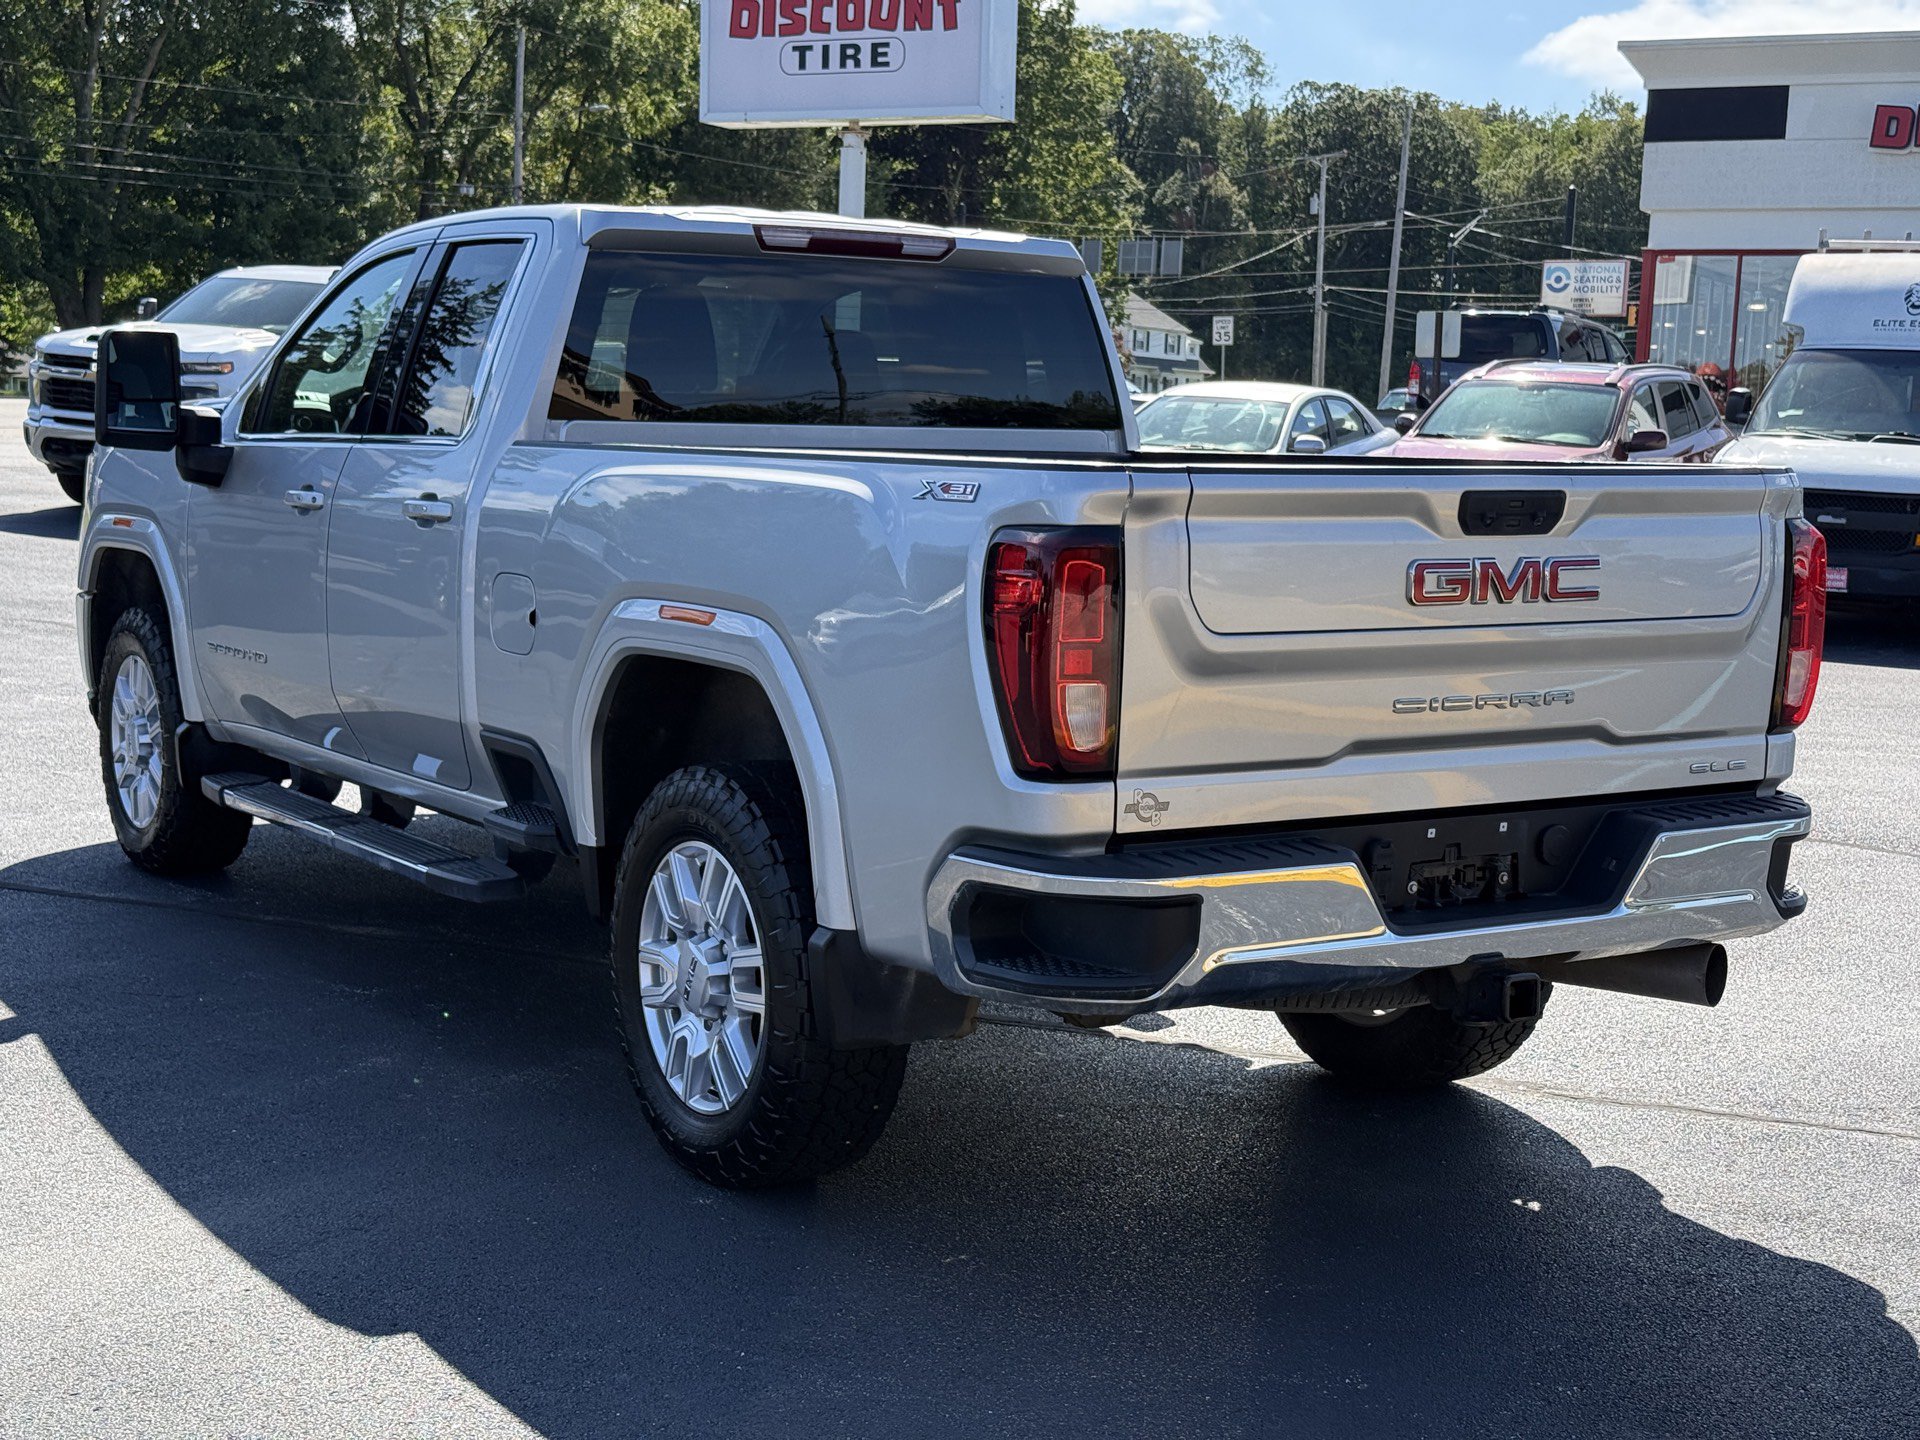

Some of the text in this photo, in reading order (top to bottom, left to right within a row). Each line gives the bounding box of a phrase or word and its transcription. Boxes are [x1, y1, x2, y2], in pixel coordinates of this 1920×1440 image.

[729, 0, 961, 39] DISCOUNT
[792, 42, 891, 71] TIRE
[1574, 265, 1622, 274] NATIONAL
[1573, 275, 1622, 284] SEATING &
[1573, 285, 1621, 294] MOBILITY
[1872, 319, 1906, 328] ELITE
[1215, 331, 1231, 342] 35
[1405, 554, 1601, 606] GMC
[1392, 689, 1577, 714] SIERRA
[1689, 759, 1747, 775] SLE
